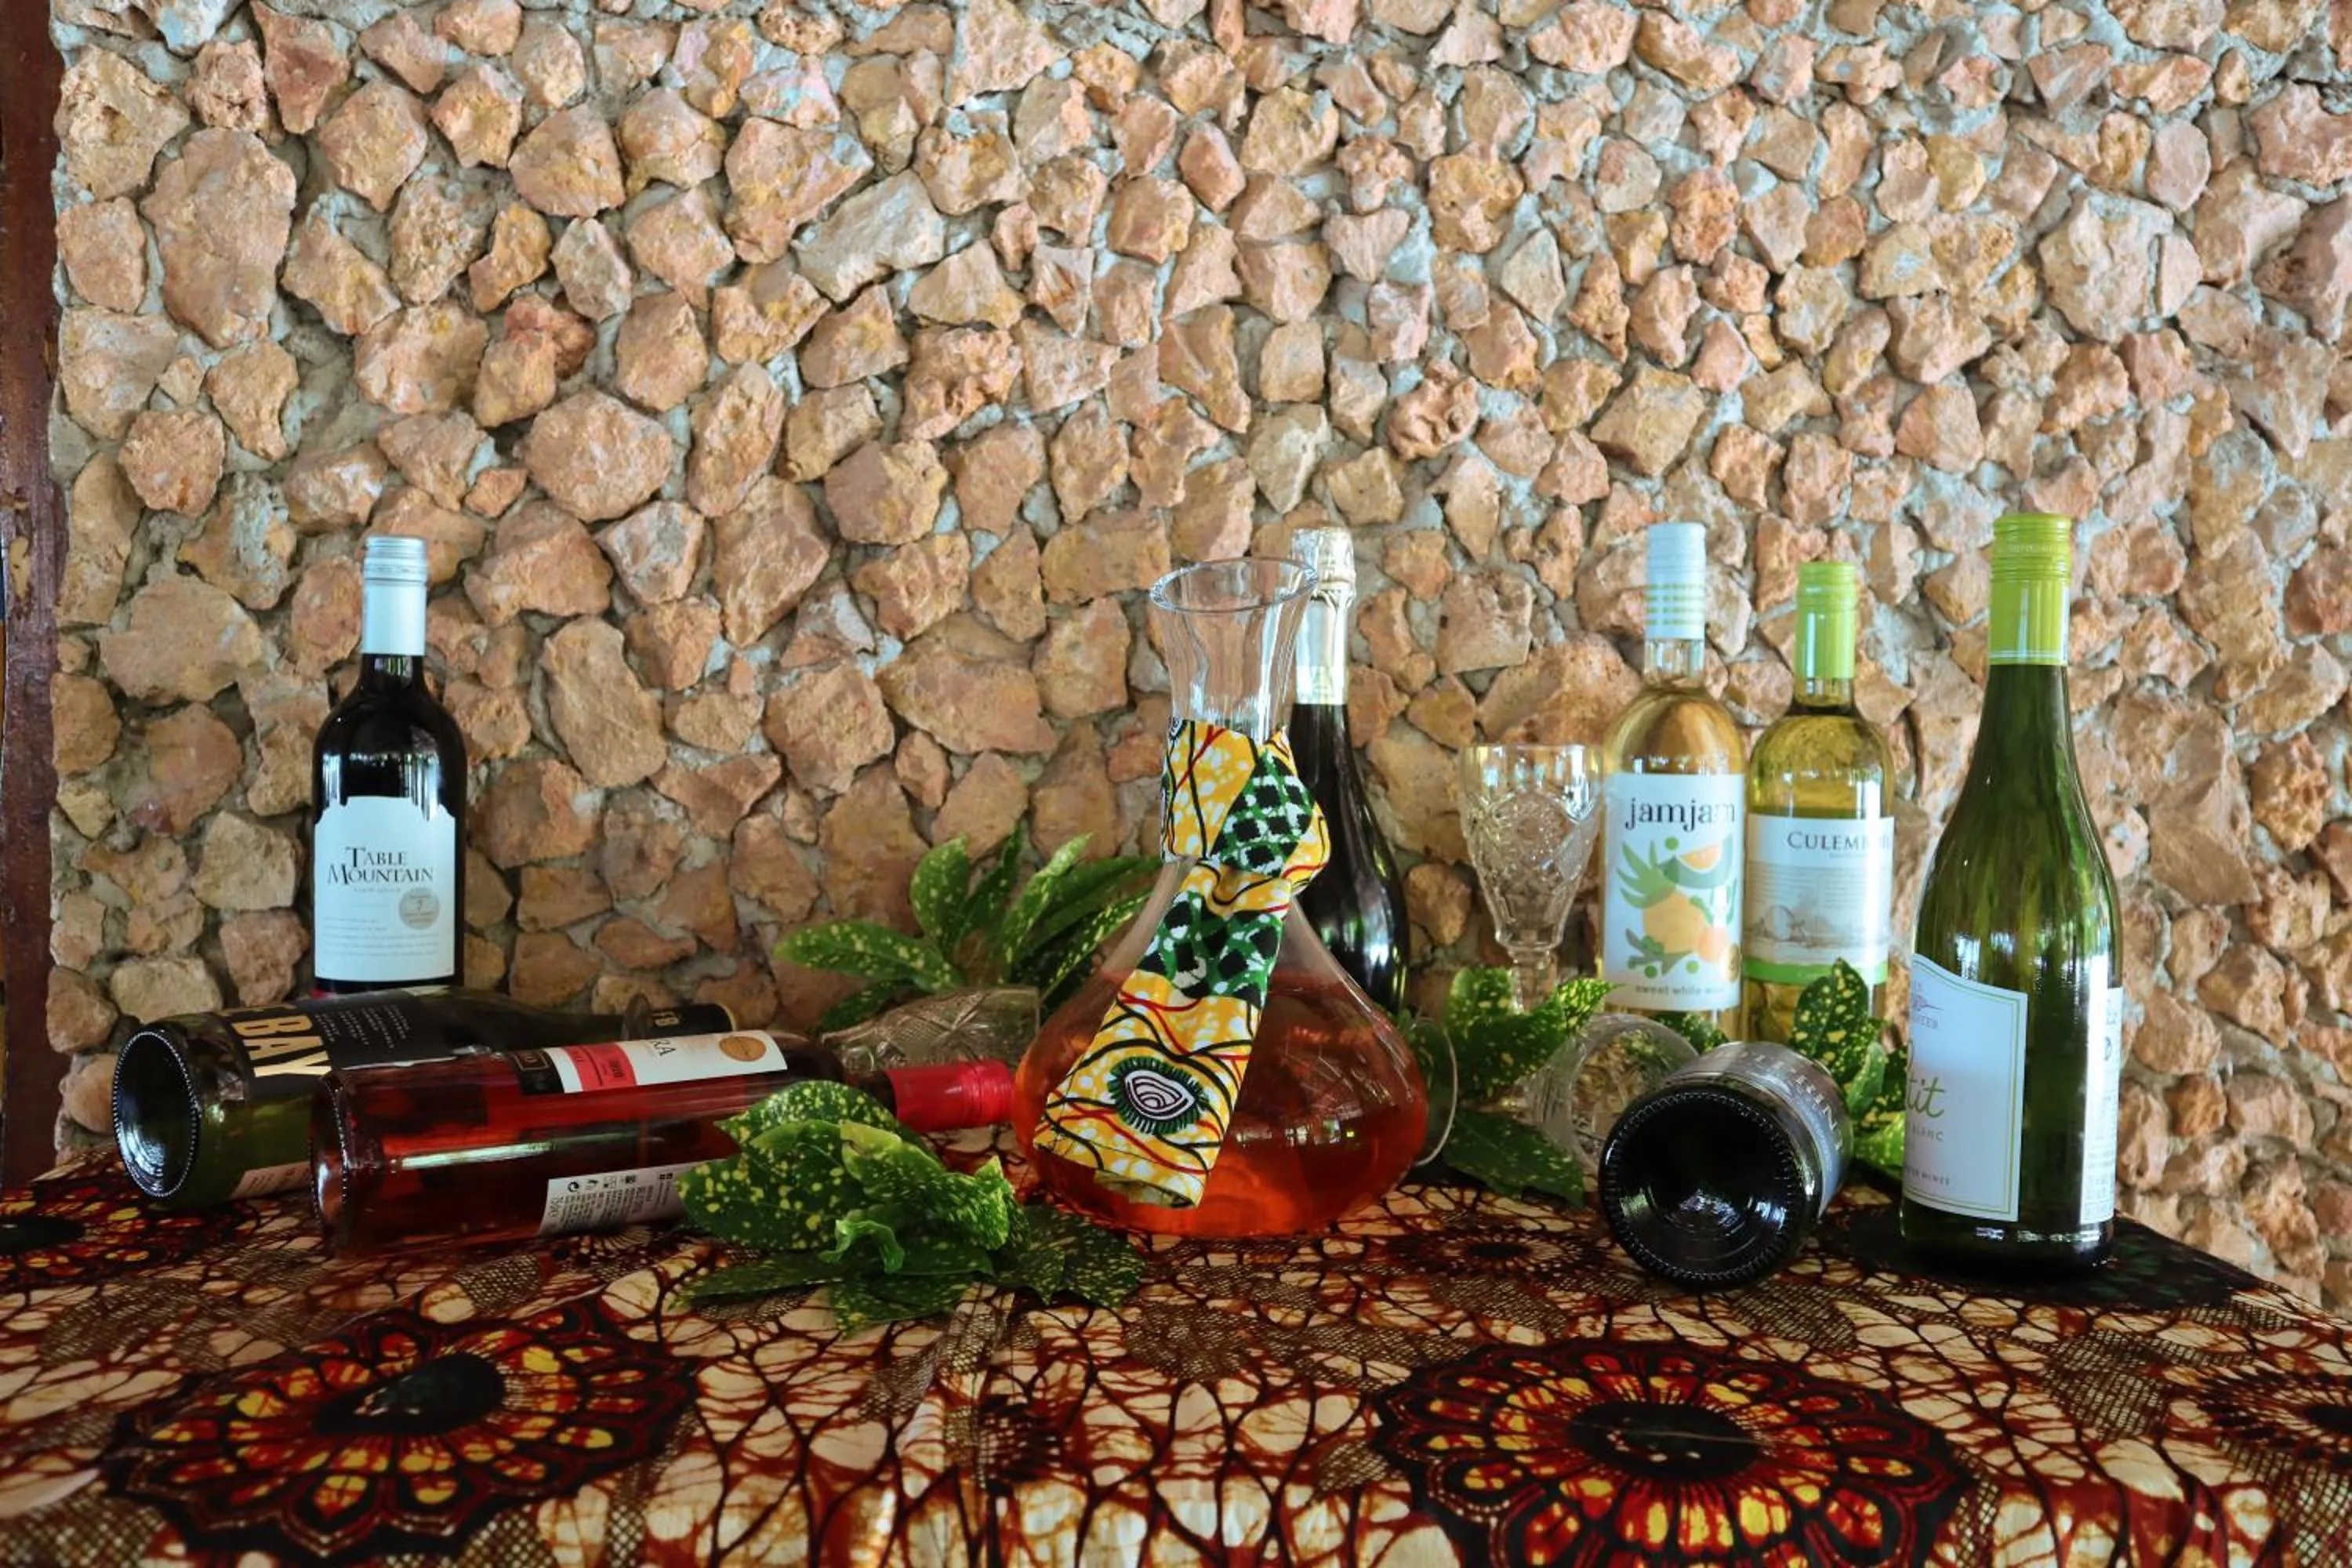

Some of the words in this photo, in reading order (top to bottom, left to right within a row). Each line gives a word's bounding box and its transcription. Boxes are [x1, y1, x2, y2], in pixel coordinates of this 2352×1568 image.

[1625, 797, 1735, 832] jamjam
[345, 846, 407, 868] TABLE
[328, 863, 434, 885] MOUNTAIN
[232, 1015, 332, 1078] BAY
